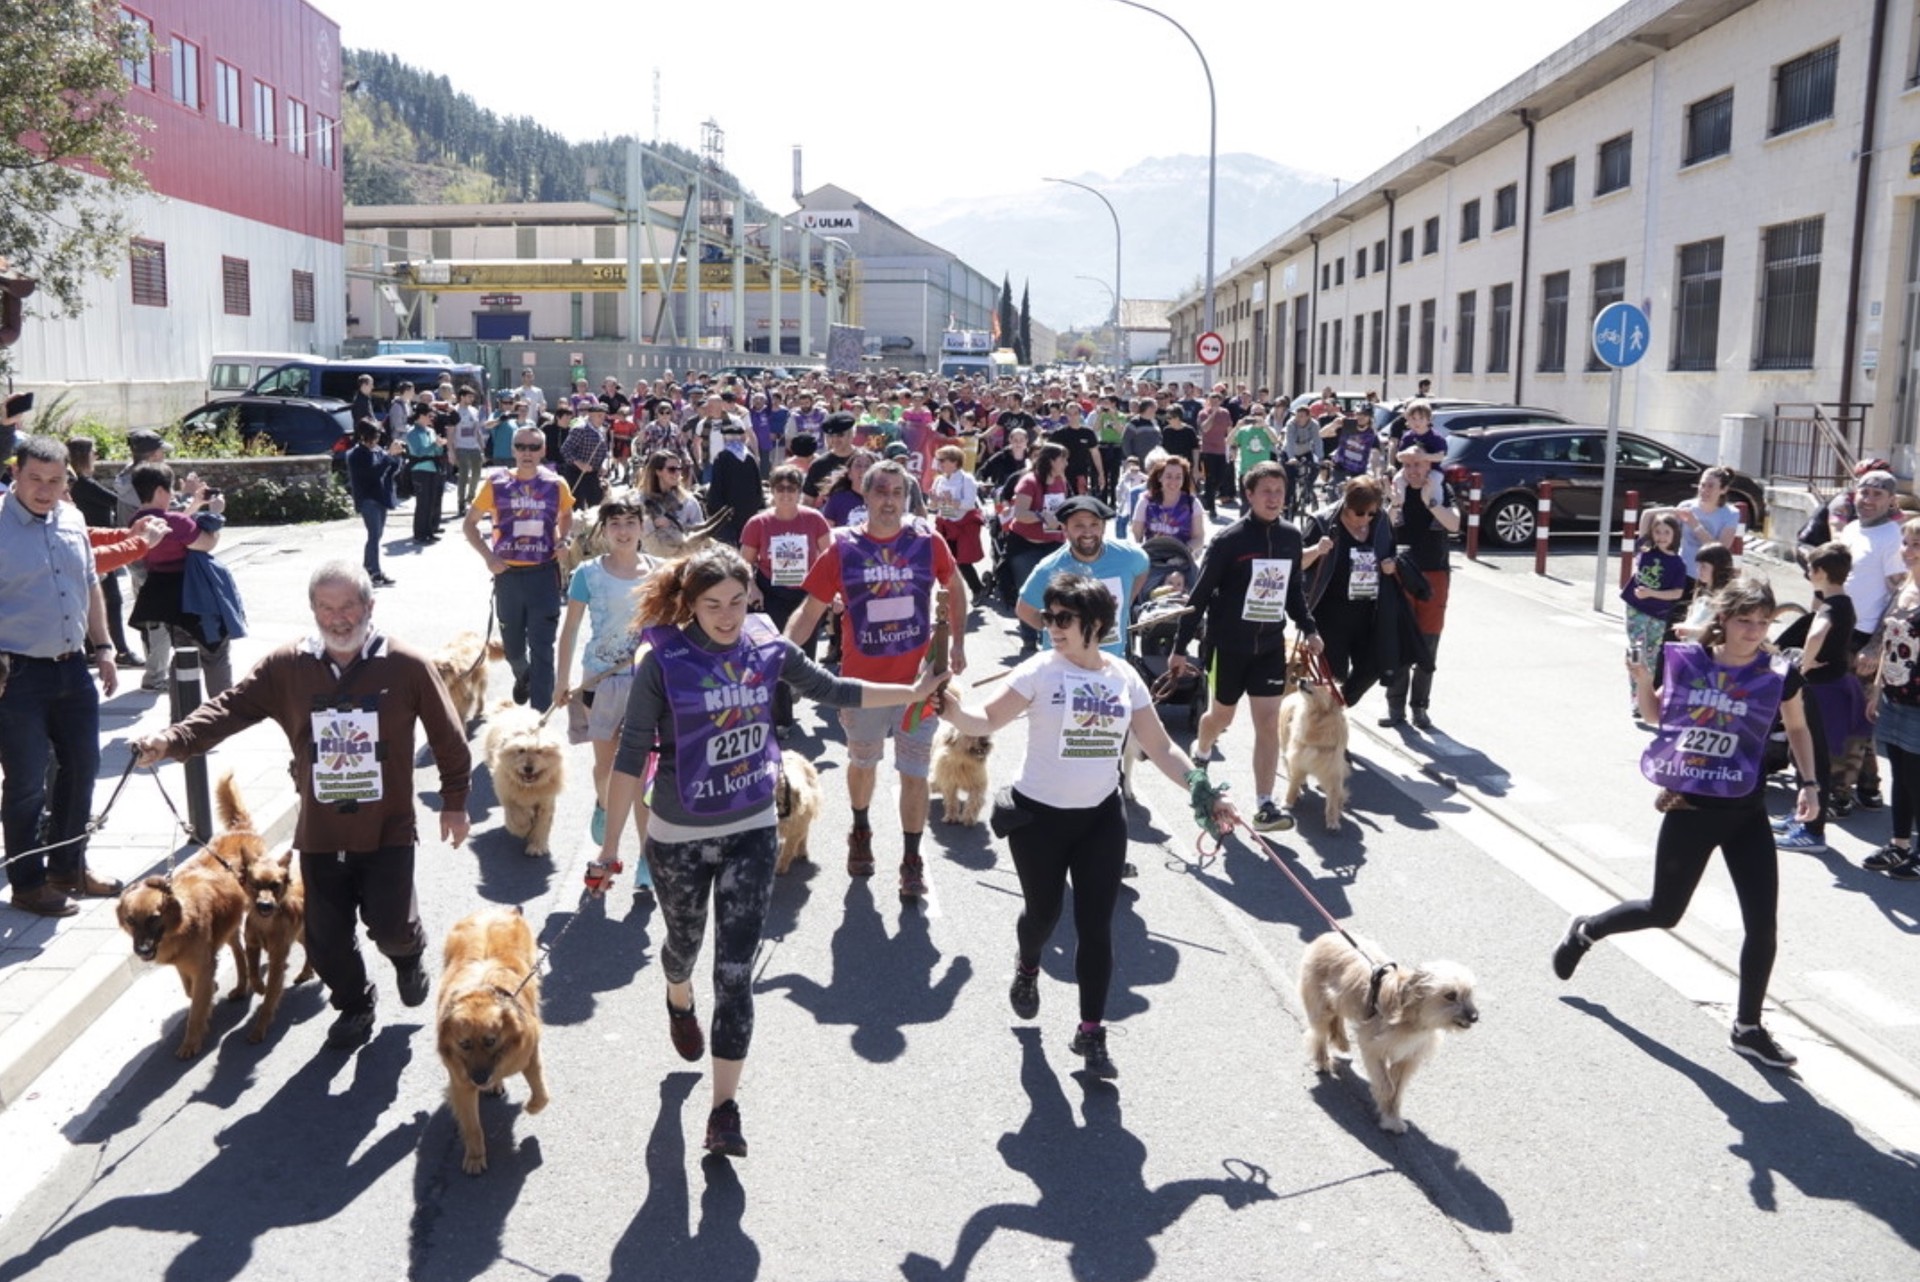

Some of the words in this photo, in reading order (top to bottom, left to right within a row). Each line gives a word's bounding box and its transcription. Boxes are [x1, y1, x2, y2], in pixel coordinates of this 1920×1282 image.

[819, 218, 853, 228] ULMA
[863, 565, 913, 583] Klika
[704, 683, 768, 712] Klika
[1073, 696, 1125, 718] Klika
[1688, 689, 1747, 716] Klika
[320, 738, 372, 755] Klika
[714, 725, 762, 761] 2270
[1683, 730, 1731, 755] 2270
[1654, 757, 1677, 777] 21.
[1680, 760, 1743, 782] korrika
[691, 779, 722, 799] 21.
